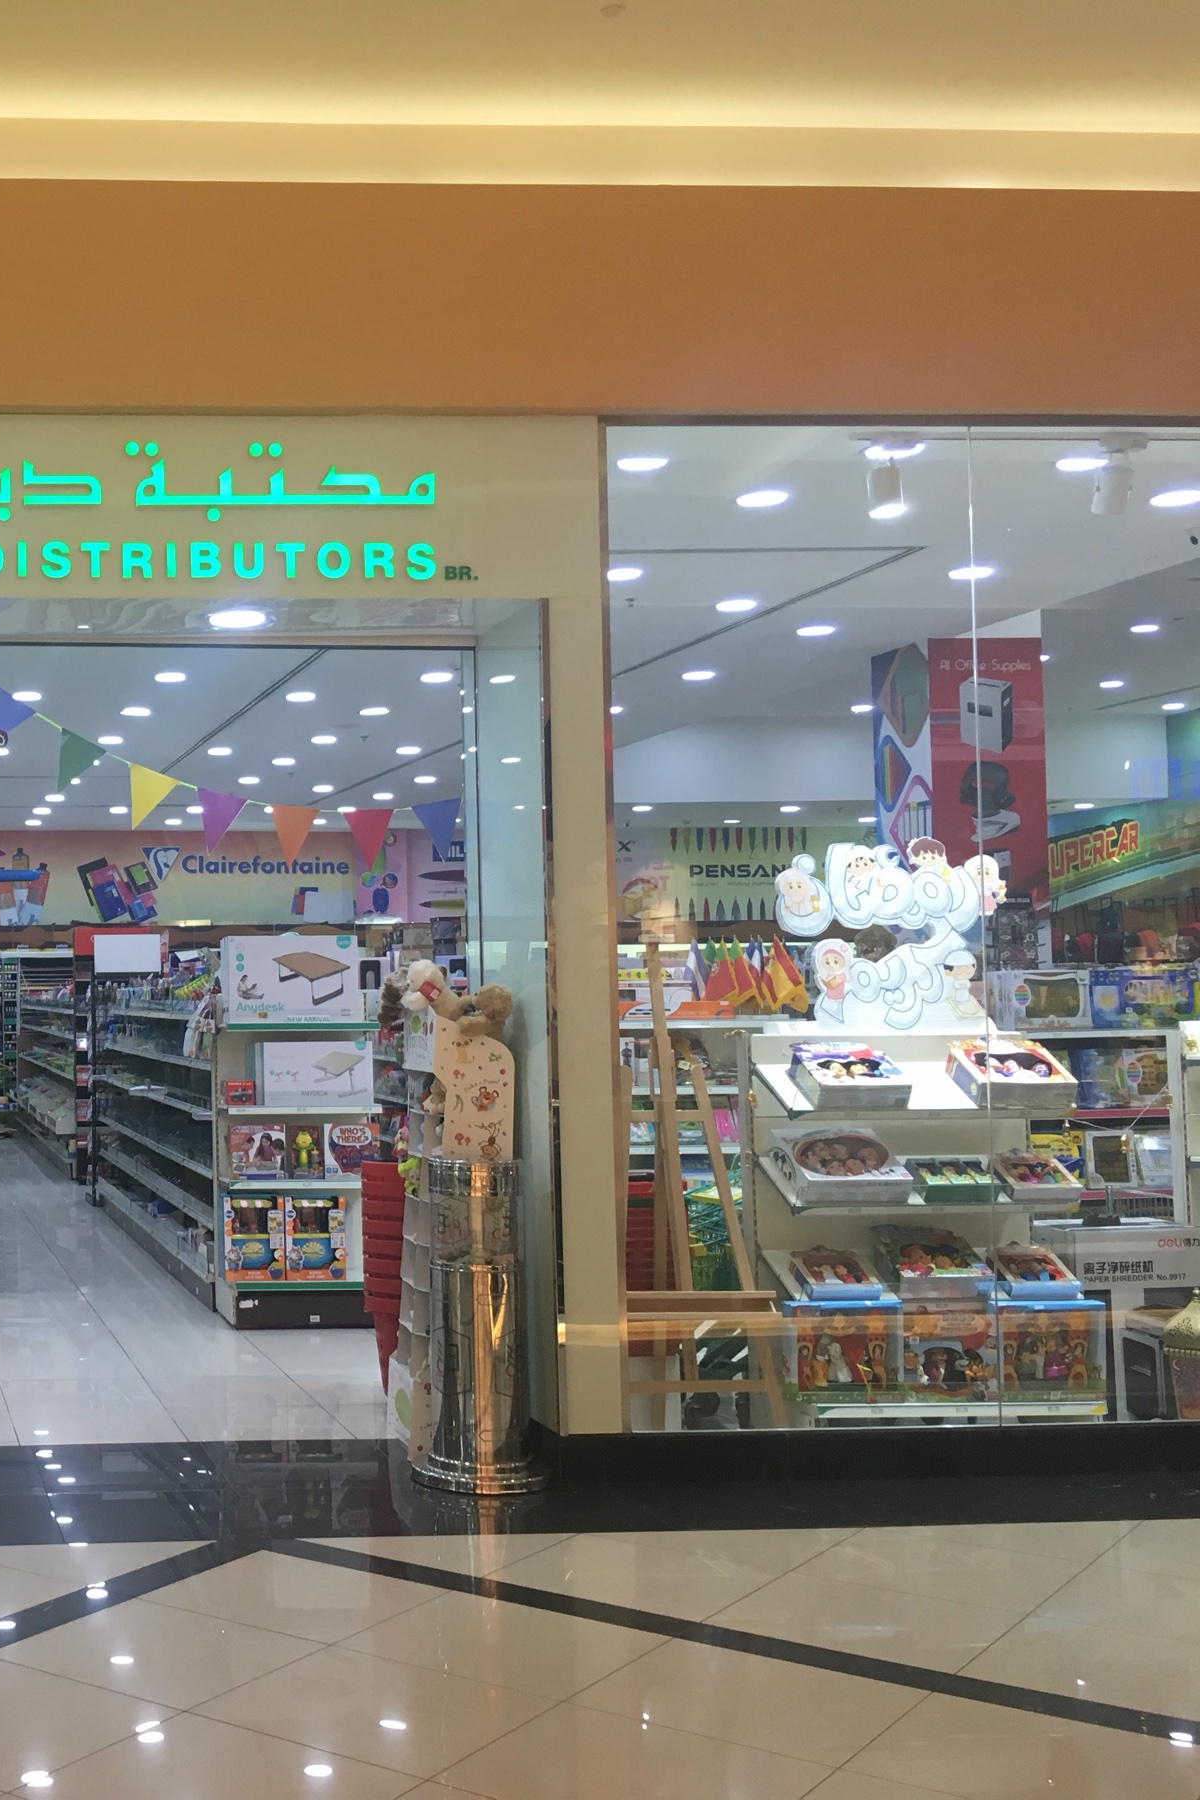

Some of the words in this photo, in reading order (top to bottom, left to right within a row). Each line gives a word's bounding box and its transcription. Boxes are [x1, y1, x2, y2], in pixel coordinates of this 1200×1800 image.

[124, 440, 436, 523] مكتبة
[444, 564, 479, 582] BR.
[954, 659, 987, 671] Offe
[1048, 820, 1140, 880] UPERCAR
[181, 854, 350, 876] Clairefontaine
[235, 1002, 285, 1013] Anydesk
[338, 1127, 367, 1136] WHO'S
[335, 1135, 370, 1144] THERE?
[1157, 1237, 1182, 1248] deli
[1084, 1275, 1110, 1283] PAPER
[1111, 1274, 1154, 1283] SHREDDER
[1156, 1273, 1187, 1281] No.9917
